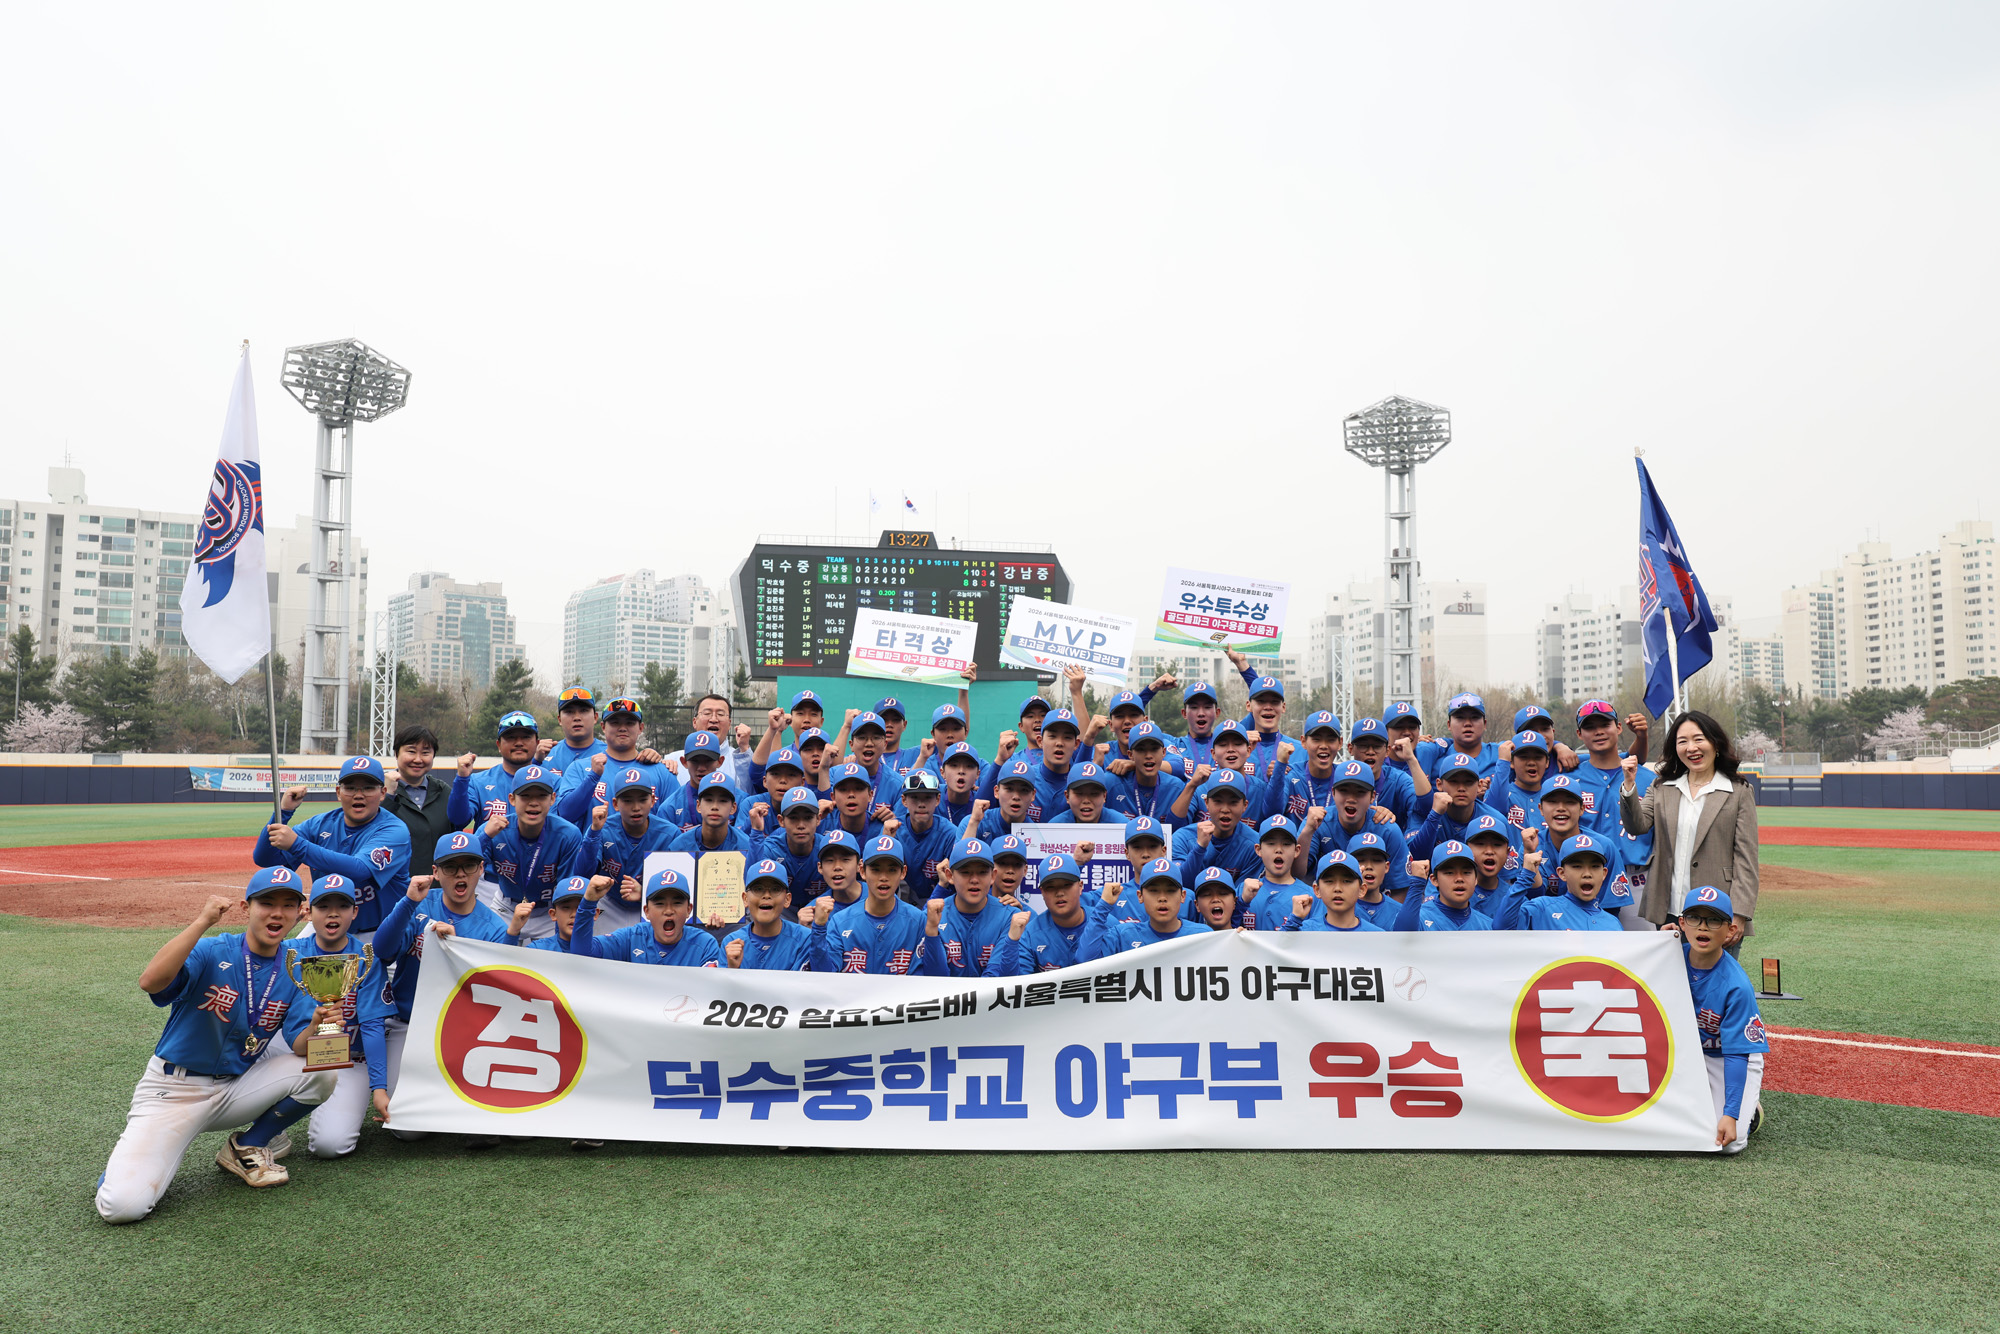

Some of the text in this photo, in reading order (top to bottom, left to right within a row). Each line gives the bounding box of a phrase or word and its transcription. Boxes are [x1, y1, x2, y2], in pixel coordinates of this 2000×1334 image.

[889, 533, 929, 546] 13:27
[762, 559, 809, 573] 덕수중
[1004, 566, 1048, 580] 강남중
[822, 574, 847, 583] 덕수중
[1179, 592, 1269, 621] 우수투수상
[1458, 603, 1472, 612] 511
[1167, 611, 1275, 636] 골드볼파크 야구용품 상품권
[876, 629, 953, 655] 타격상
[1034, 620, 1107, 650] MVP
[1018, 637, 1120, 666] 최고급 수제(WE) 글러브
[903, 653, 936, 665] 야구용품
[938, 659, 963, 669] 상품권
[1051, 659, 1094, 675] KSM포츠
[863, 712, 876, 721] D
[1139, 723, 1153, 735] D
[695, 733, 709, 746] D
[1522, 731, 1536, 744] D
[955, 742, 969, 753] D
[352, 757, 370, 771] D
[1454, 754, 1469, 766] D
[525, 766, 542, 780] D
[1345, 762, 1361, 776] D
[229, 772, 252, 781] 2026
[256, 772, 297, 782] 일요문배
[1219, 770, 1234, 783] D
[792, 789, 807, 802] D
[451, 834, 468, 850] D
[877, 836, 893, 851] D
[966, 841, 982, 854] D
[1575, 834, 1592, 848] D
[1048, 856, 1063, 871] D
[1330, 850, 1347, 863] D
[759, 860, 776, 874] D
[271, 868, 292, 884] D
[324, 875, 344, 889] D
[661, 871, 678, 885] D
[1091, 865, 1129, 890] 훈련비
[1698, 887, 1718, 902] D
[703, 966, 1384, 1030] 2026 일요신문배 서울특별시 U15 야구대회
[470, 983, 560, 1093] 경
[1537, 980, 1650, 1093] 축
[647, 1041, 1464, 1121] 덕수중학교 야구부 우승
